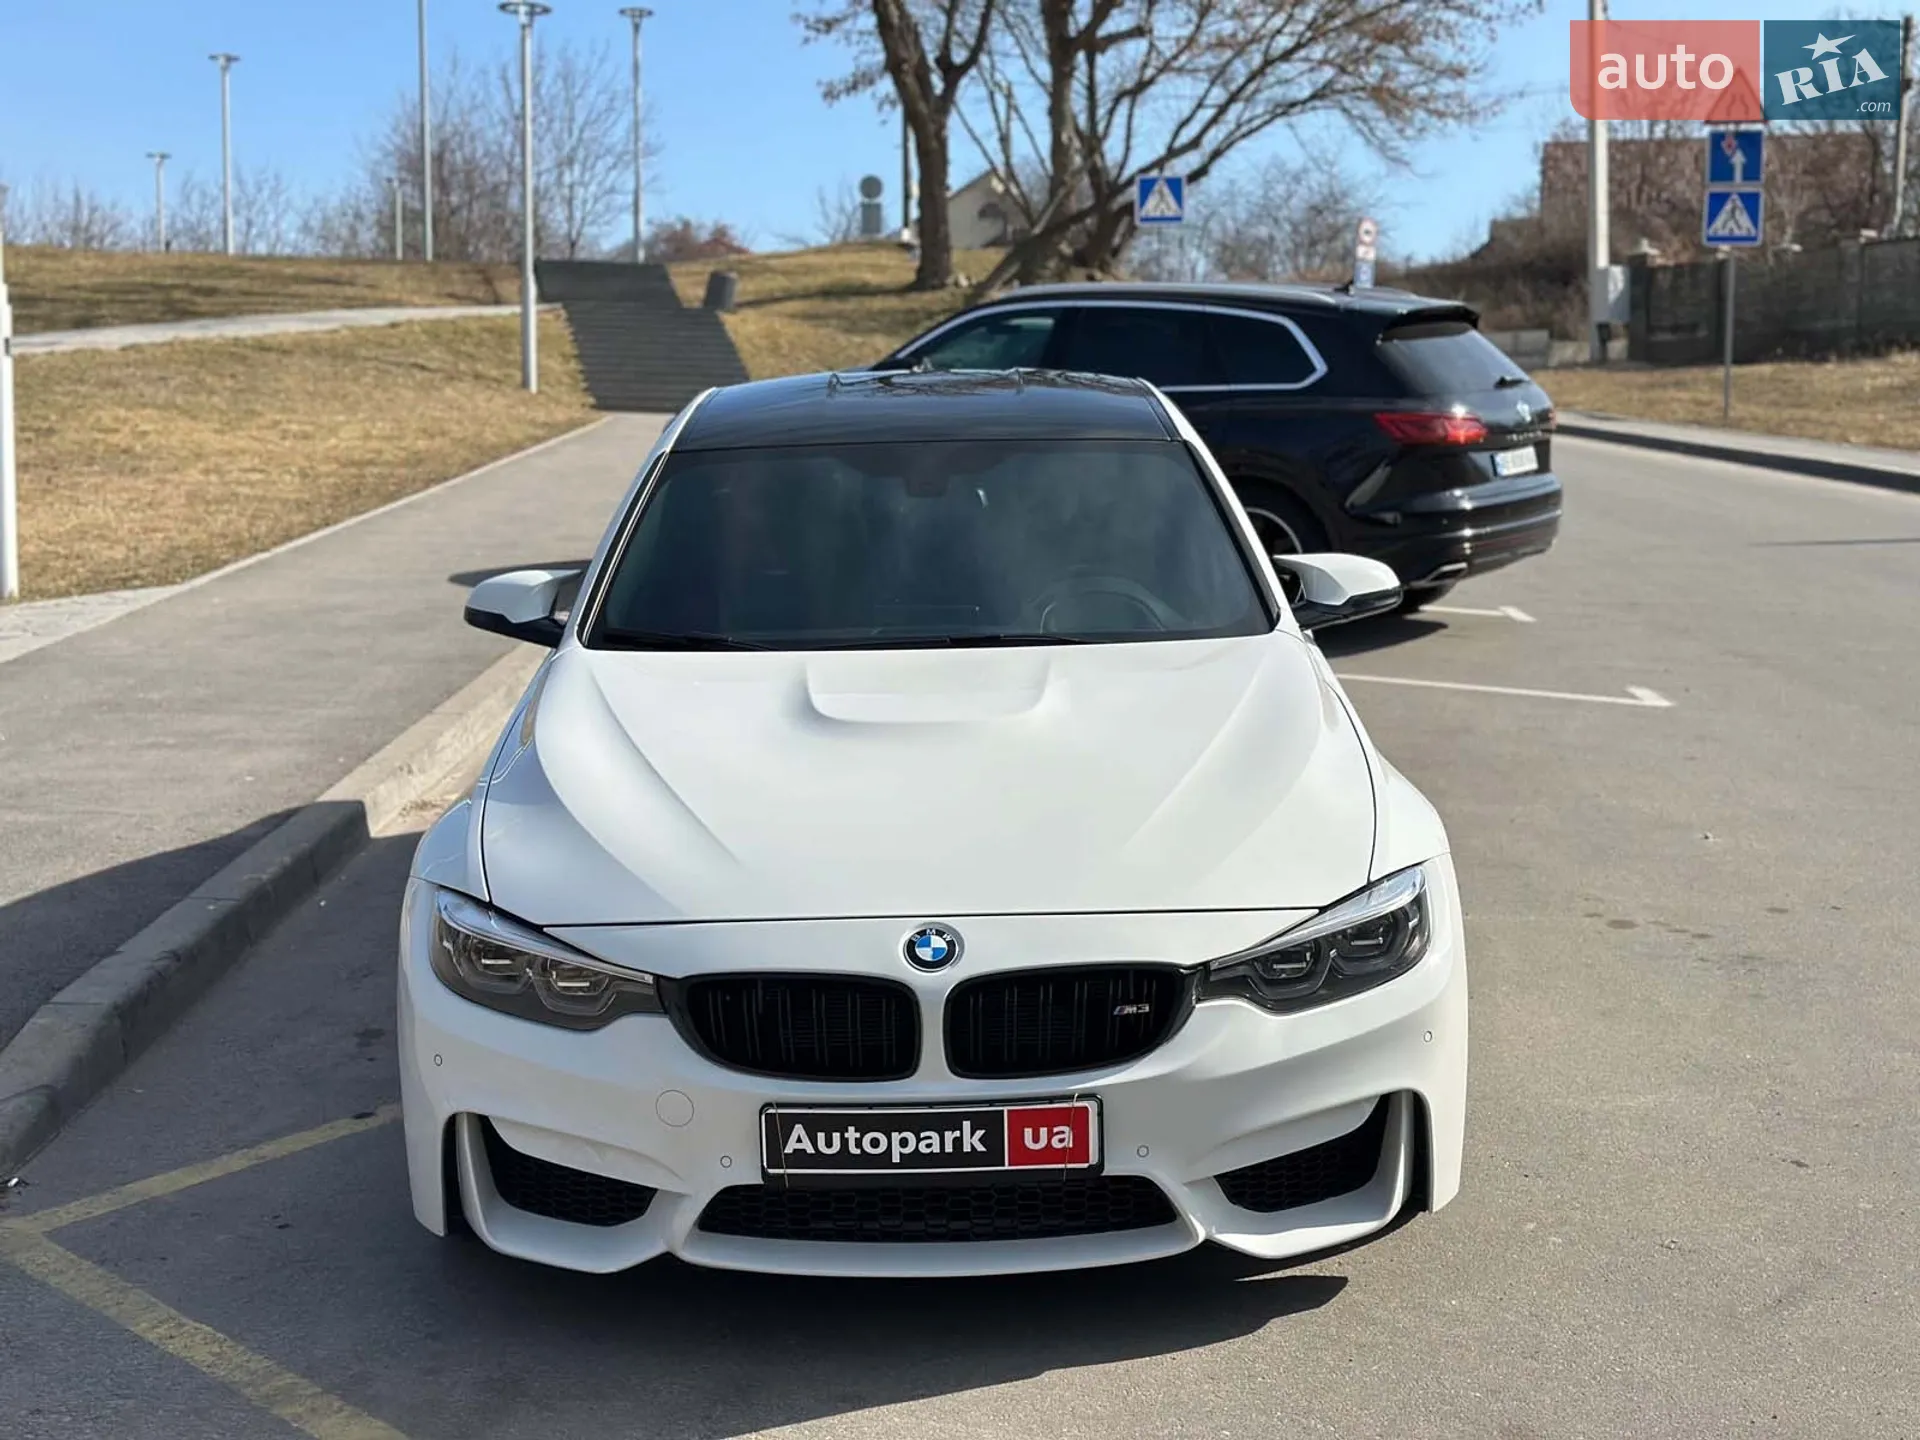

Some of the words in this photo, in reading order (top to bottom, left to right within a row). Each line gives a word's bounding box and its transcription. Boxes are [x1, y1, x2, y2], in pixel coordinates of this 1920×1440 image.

[910, 928, 953, 942] BMW
[1115, 1003, 1150, 1015] M3
[783, 1121, 987, 1163] Autopark
[1023, 1125, 1074, 1150] ua
